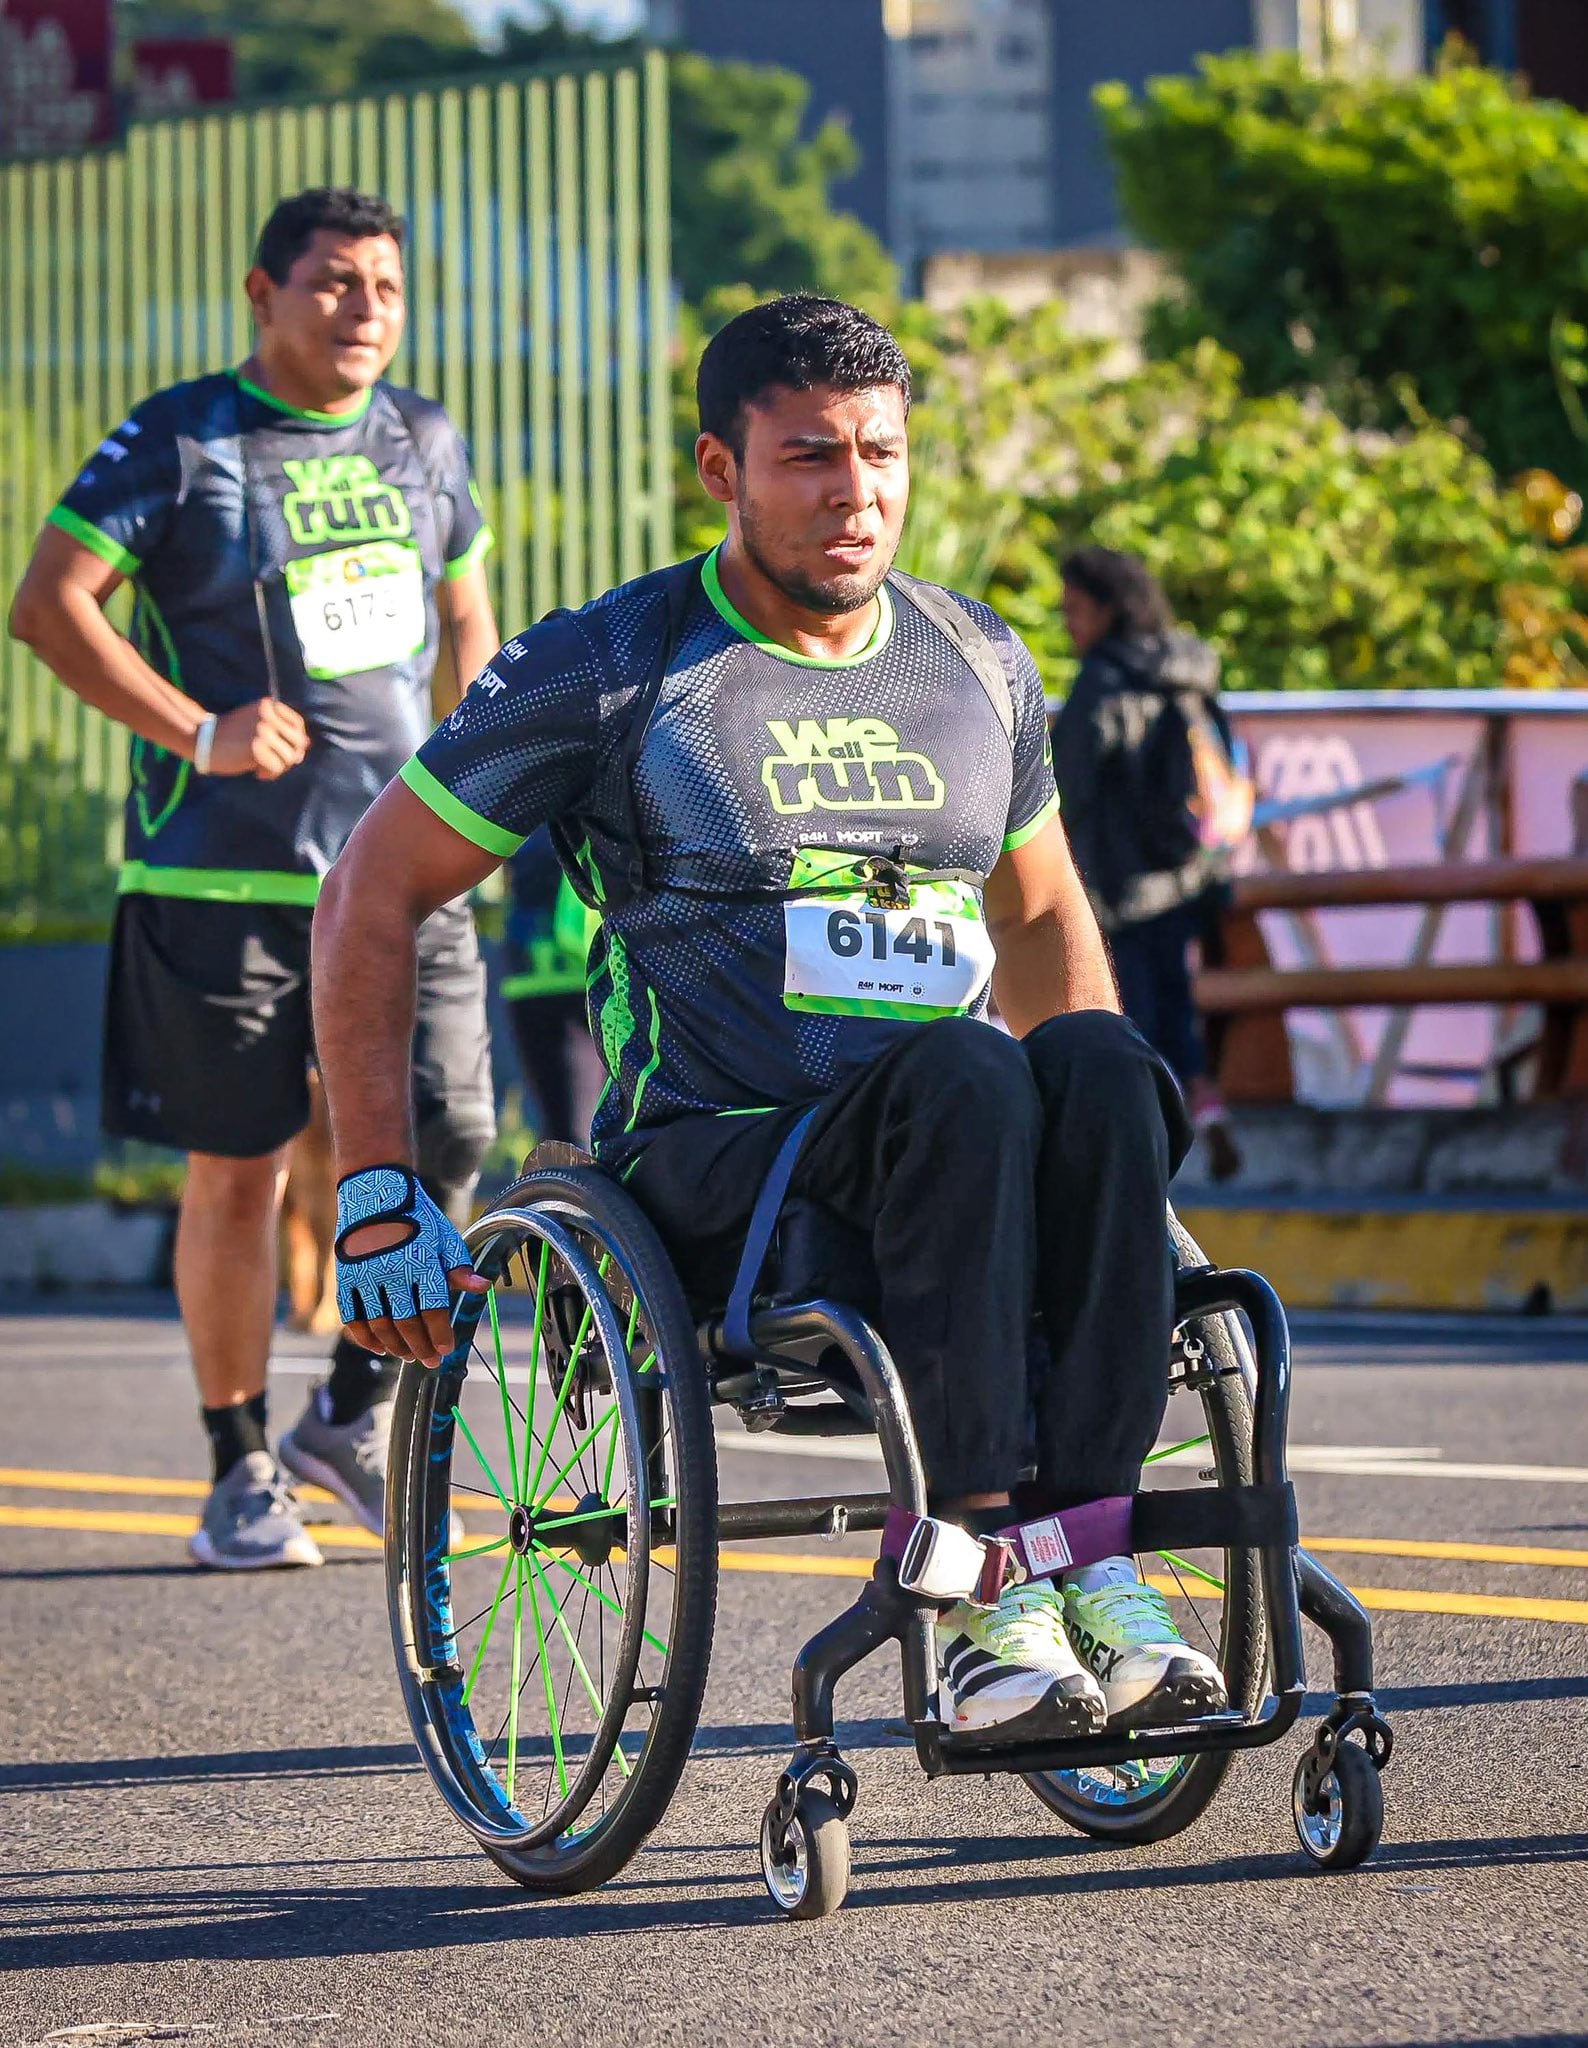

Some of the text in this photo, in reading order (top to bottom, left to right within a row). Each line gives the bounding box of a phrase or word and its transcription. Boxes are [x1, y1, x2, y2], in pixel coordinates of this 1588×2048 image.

[293, 493, 402, 535] run
[828, 741, 864, 758] all
[768, 757, 938, 807] run
[799, 831, 883, 843] R4H MOPT
[827, 909, 956, 966] 6141
[858, 981, 904, 993] R4H MOPT
